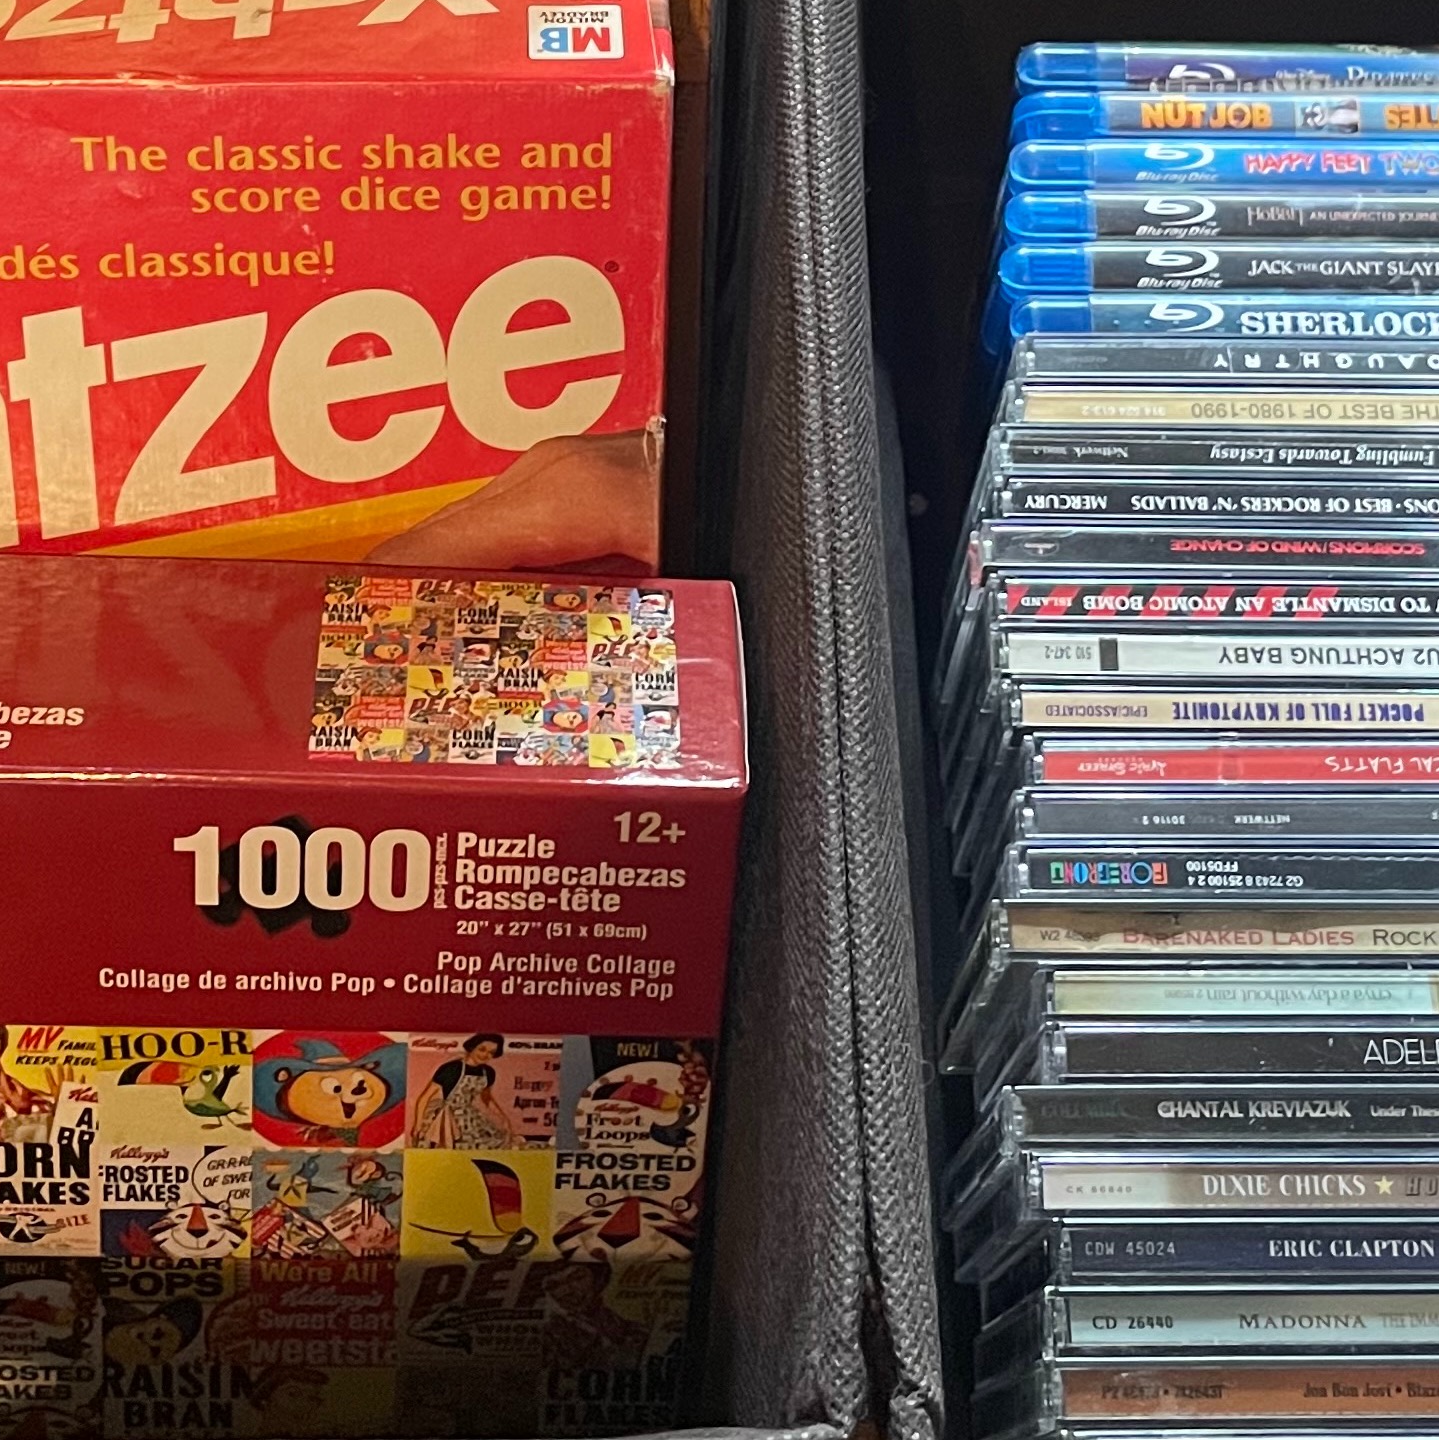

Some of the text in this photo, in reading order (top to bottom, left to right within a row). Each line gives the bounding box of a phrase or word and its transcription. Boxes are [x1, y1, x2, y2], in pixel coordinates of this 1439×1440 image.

[1139, 101, 1272, 129] NUT JOB
[71, 132, 613, 172] The classic shake and
[1244, 151, 1372, 174] HAPPY FEET
[190, 174, 613, 221] score dice game!
[99, 240, 336, 287] classique!
[1247, 259, 1294, 276] JACK
[1319, 260, 1383, 276] GIANT
[1190, 402, 1297, 419] 1980-1990
[1302, 402, 1331, 419] OF
[1341, 403, 1395, 420] BEST
[1209, 444, 1274, 463] Ecstasy
[1278, 448, 1353, 465] Towards
[1355, 444, 1435, 467] Fumbling
[1024, 494, 1109, 510] MERCURY
[1130, 494, 1209, 511] BALLADS
[1241, 495, 1321, 511] ROCKERS
[1326, 497, 1351, 512] OF
[1354, 498, 1393, 513] BEST
[1169, 538, 1244, 552] CHANGE
[1082, 595, 1431, 612] TO DISMANTLE AN ATOMIC BOMB
[1218, 646, 1283, 664] BABY
[1290, 647, 1405, 665] ACHTUNG
[1172, 701, 1280, 721] KRYPTONITE
[1284, 702, 1305, 720] OF
[1311, 702, 1353, 720] FULL
[1357, 702, 1425, 721] POCKET
[1323, 755, 1404, 773] FLATTS
[614, 810, 687, 845] 12+
[1234, 814, 1291, 824] NETTWERK
[455, 831, 555, 859] Puzzle
[172, 824, 433, 913] 1000
[454, 858, 687, 890] Rompecabezas
[453, 884, 622, 914] Casse-tête
[545, 920, 648, 941] (51 69cm)
[1122, 929, 1264, 946] BARENAKED
[1271, 930, 1355, 947] LADIES
[1371, 927, 1435, 946] ROCK
[436, 950, 676, 980] Pop Archive Collage
[98, 967, 674, 1002] Collage de archivo Pop Collage d'archives Pop
[616, 1041, 660, 1058] NEW!
[1156, 1101, 1244, 1119] CHANTAL
[1247, 1100, 1352, 1119] KREVIAZUK
[554, 1152, 697, 1172] FROSTED
[553, 1172, 671, 1192] FLAKES
[1200, 1174, 1271, 1197] DIXIE
[1278, 1174, 1367, 1197] CHICKS
[102, 1183, 181, 1203] FLAKES
[1125, 1241, 1177, 1257] 45024
[1267, 1239, 1323, 1258] ERIC
[1329, 1238, 1435, 1258] CLAPTON
[1091, 1315, 1118, 1330] CD
[1127, 1315, 1174, 1330] 26440
[1238, 1312, 1367, 1330] MADONNA
